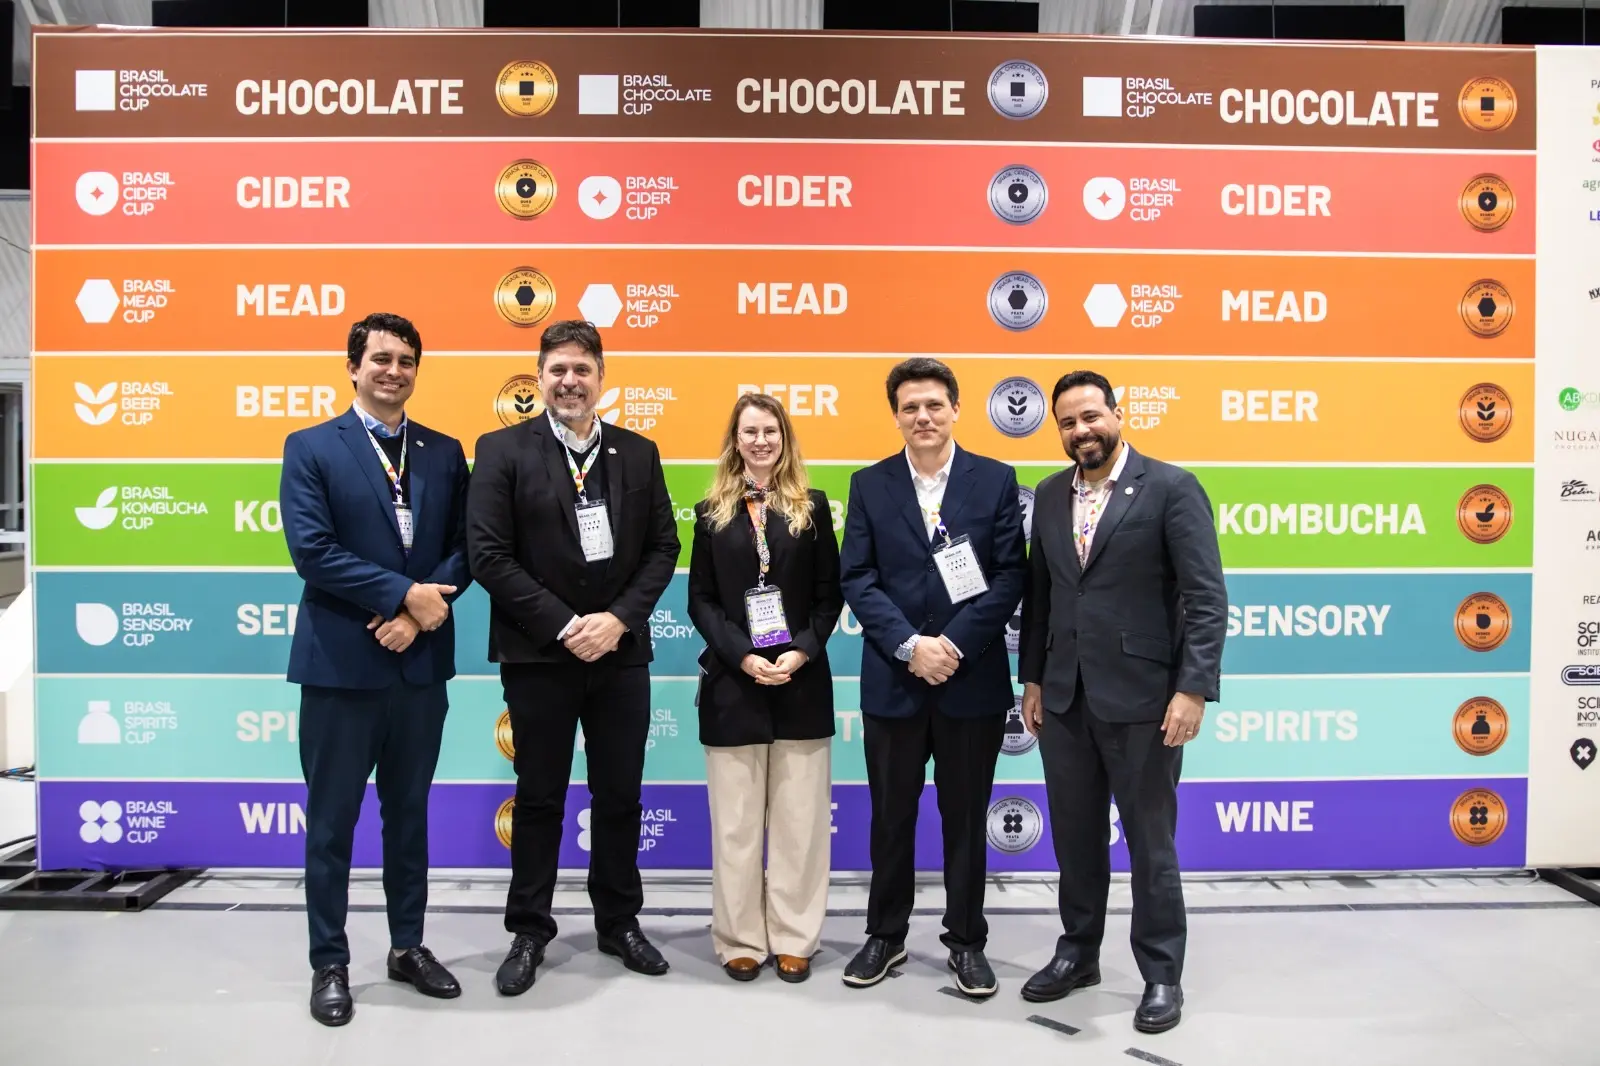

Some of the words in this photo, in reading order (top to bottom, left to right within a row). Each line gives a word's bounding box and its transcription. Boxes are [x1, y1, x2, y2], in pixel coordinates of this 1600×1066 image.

[120, 70, 168, 83] BRASIL
[624, 75, 672, 86] BRASIL
[120, 84, 207, 97] CHOCOLATE
[1127, 78, 1174, 90] BRASIL
[236, 79, 463, 115] CHOCOLATE
[623, 89, 711, 101] CHOCOLATE
[737, 78, 965, 115] CHOCOLATE
[1127, 91, 1212, 104] CHOCOLATE
[120, 98, 149, 111] CUP
[623, 103, 652, 115] CUP
[1127, 105, 1155, 117] CUP
[1220, 88, 1438, 127] CHOCOLATE
[123, 172, 175, 185] BRASIL
[626, 177, 678, 189] BRASIL
[1130, 178, 1181, 191] BRASIL
[123, 187, 167, 200] CIDER
[237, 176, 350, 208] CIDER
[738, 175, 852, 207] CIDER
[626, 192, 670, 204] CIDER
[1130, 193, 1173, 206] CIDER
[1221, 184, 1331, 216] CIDER
[123, 202, 154, 215] CUP
[626, 207, 657, 219] CUP
[1130, 208, 1160, 221] CUP
[123, 280, 175, 293] BRASIL
[627, 284, 679, 297] BRASIL
[1131, 285, 1182, 298] BRASIL
[123, 293, 167, 308] MEAD
[237, 284, 345, 316] MEAD
[738, 283, 847, 314] MEAD
[627, 300, 671, 312] MEAD
[1131, 300, 1175, 313] MEAD
[1222, 290, 1327, 322] MEAD
[123, 310, 154, 323] CUP
[626, 315, 658, 328] CUP
[1131, 315, 1162, 327] CUP
[121, 382, 173, 395] BRASIL
[625, 387, 677, 400] BRASIL
[1129, 386, 1180, 400] BRASIL
[121, 396, 160, 411] BEER
[236, 386, 337, 418] BEER
[1129, 401, 1167, 414] BEER
[1222, 390, 1318, 421] BEER
[625, 402, 663, 416] BEER
[122, 412, 153, 425] CUP
[624, 418, 656, 431] CUP
[1129, 416, 1160, 429] CUP
[1554, 430, 1600, 442] NUGA
[121, 486, 174, 500] BRASIL
[122, 501, 208, 515] KOMBUCHA
[122, 517, 153, 530] CUP
[1219, 504, 1426, 535] KOMBUCHA
[123, 603, 175, 616] BRASIL
[648, 610, 677, 623] ASIL
[1226, 605, 1391, 636] SENSORY
[123, 618, 192, 631] SENSORY
[1578, 621, 1600, 635] SCI
[650, 625, 695, 638] SORY
[123, 633, 154, 646] CUP
[1577, 634, 1598, 648] OF
[124, 701, 176, 714] BRASIL
[1578, 696, 1600, 709] SCI
[125, 716, 177, 729] SPIRITS
[1216, 710, 1357, 742] SPIRITS
[648, 724, 678, 737] RITS
[125, 731, 156, 744] CUP
[126, 801, 178, 814] BRASIL
[127, 816, 165, 828] WINE
[239, 802, 307, 834] WIN
[1216, 801, 1313, 832] WINE
[641, 824, 664, 836] INE
[127, 831, 158, 843] CUP
[638, 839, 656, 851] UP
